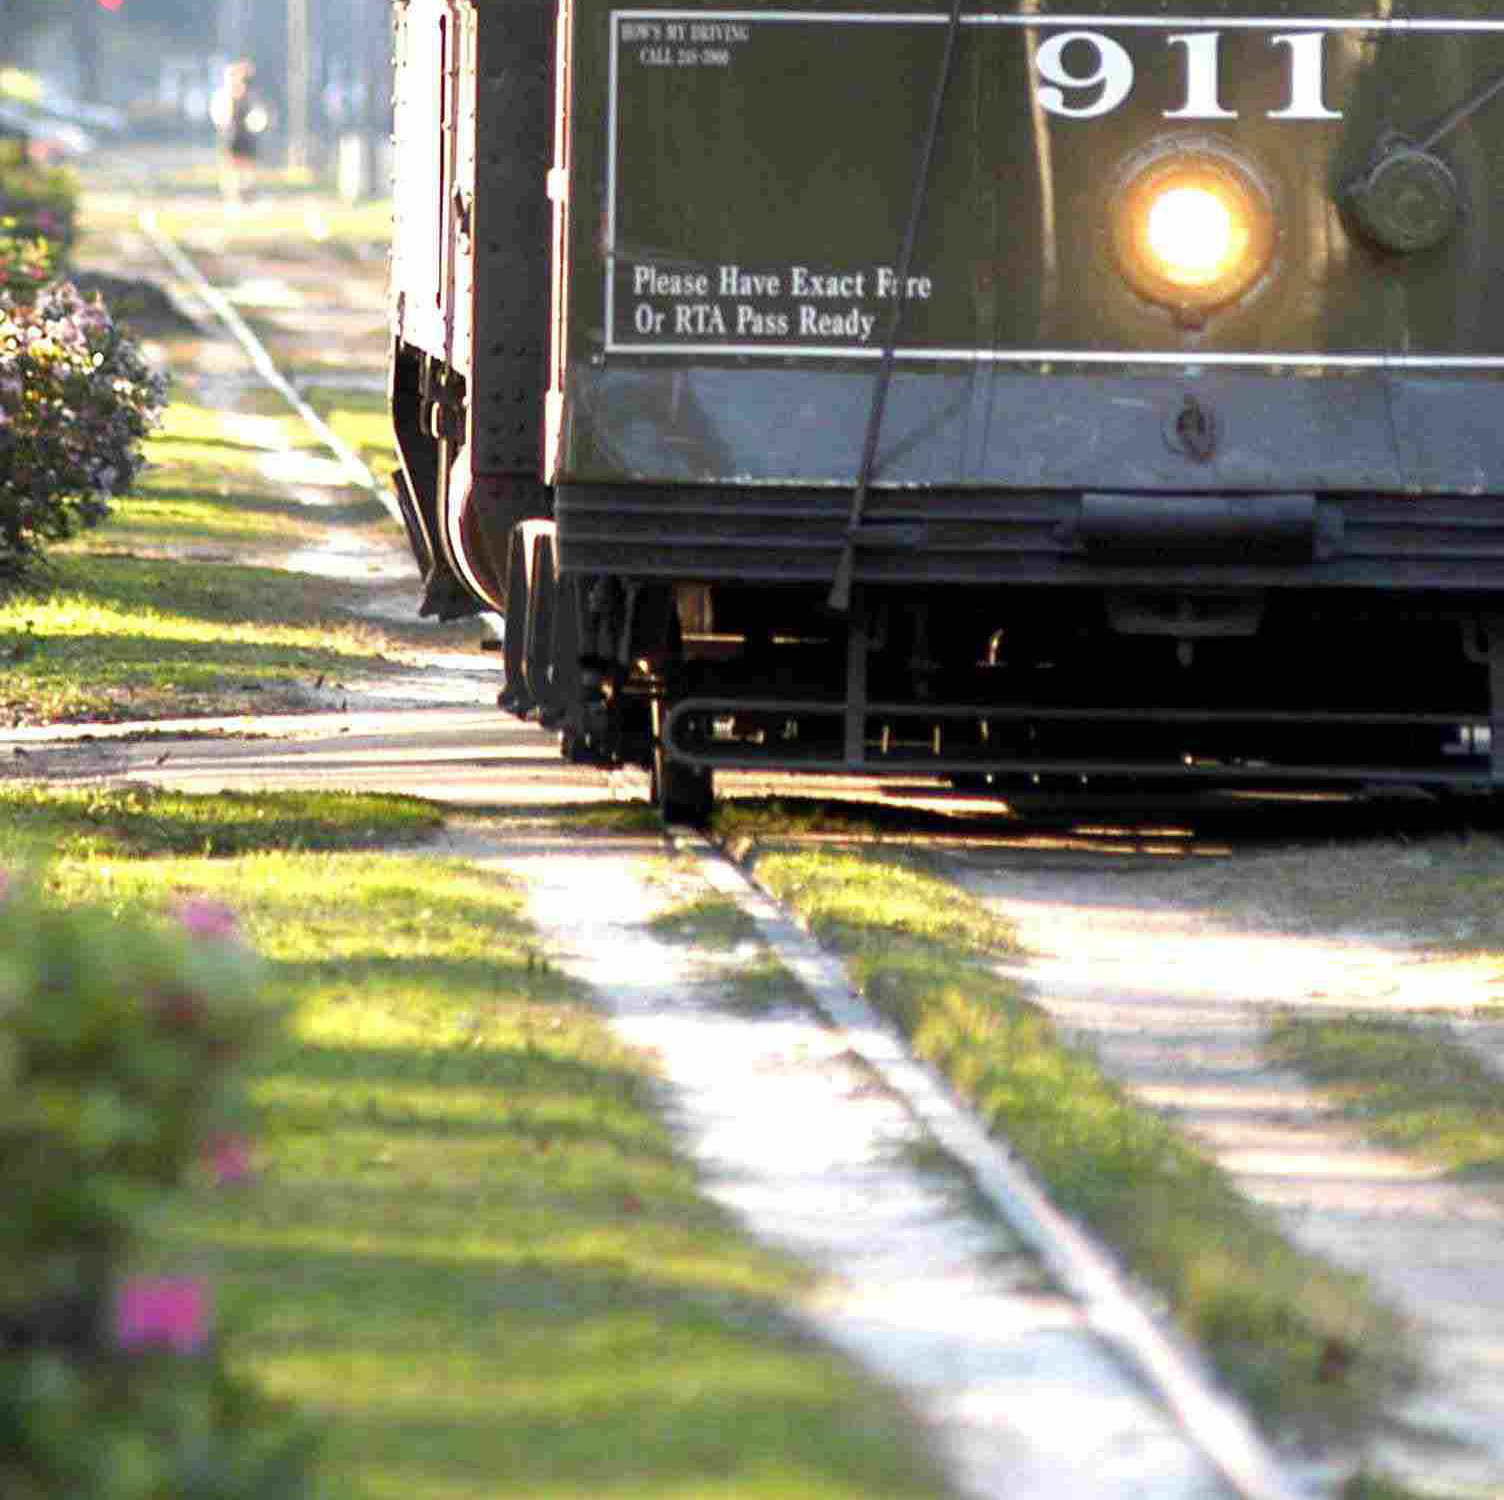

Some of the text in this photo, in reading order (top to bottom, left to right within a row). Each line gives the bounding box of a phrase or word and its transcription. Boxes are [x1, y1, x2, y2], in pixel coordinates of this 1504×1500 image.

[664, 22, 688, 41] MY
[690, 22, 750, 42] DRIVING
[639, 46, 673, 66] CALL
[1033, 29, 1344, 119] 911
[633, 265, 709, 296] Please
[719, 265, 781, 297] Have
[791, 267, 865, 298] Exact
[634, 303, 876, 342] Or RTA Pass Ready
